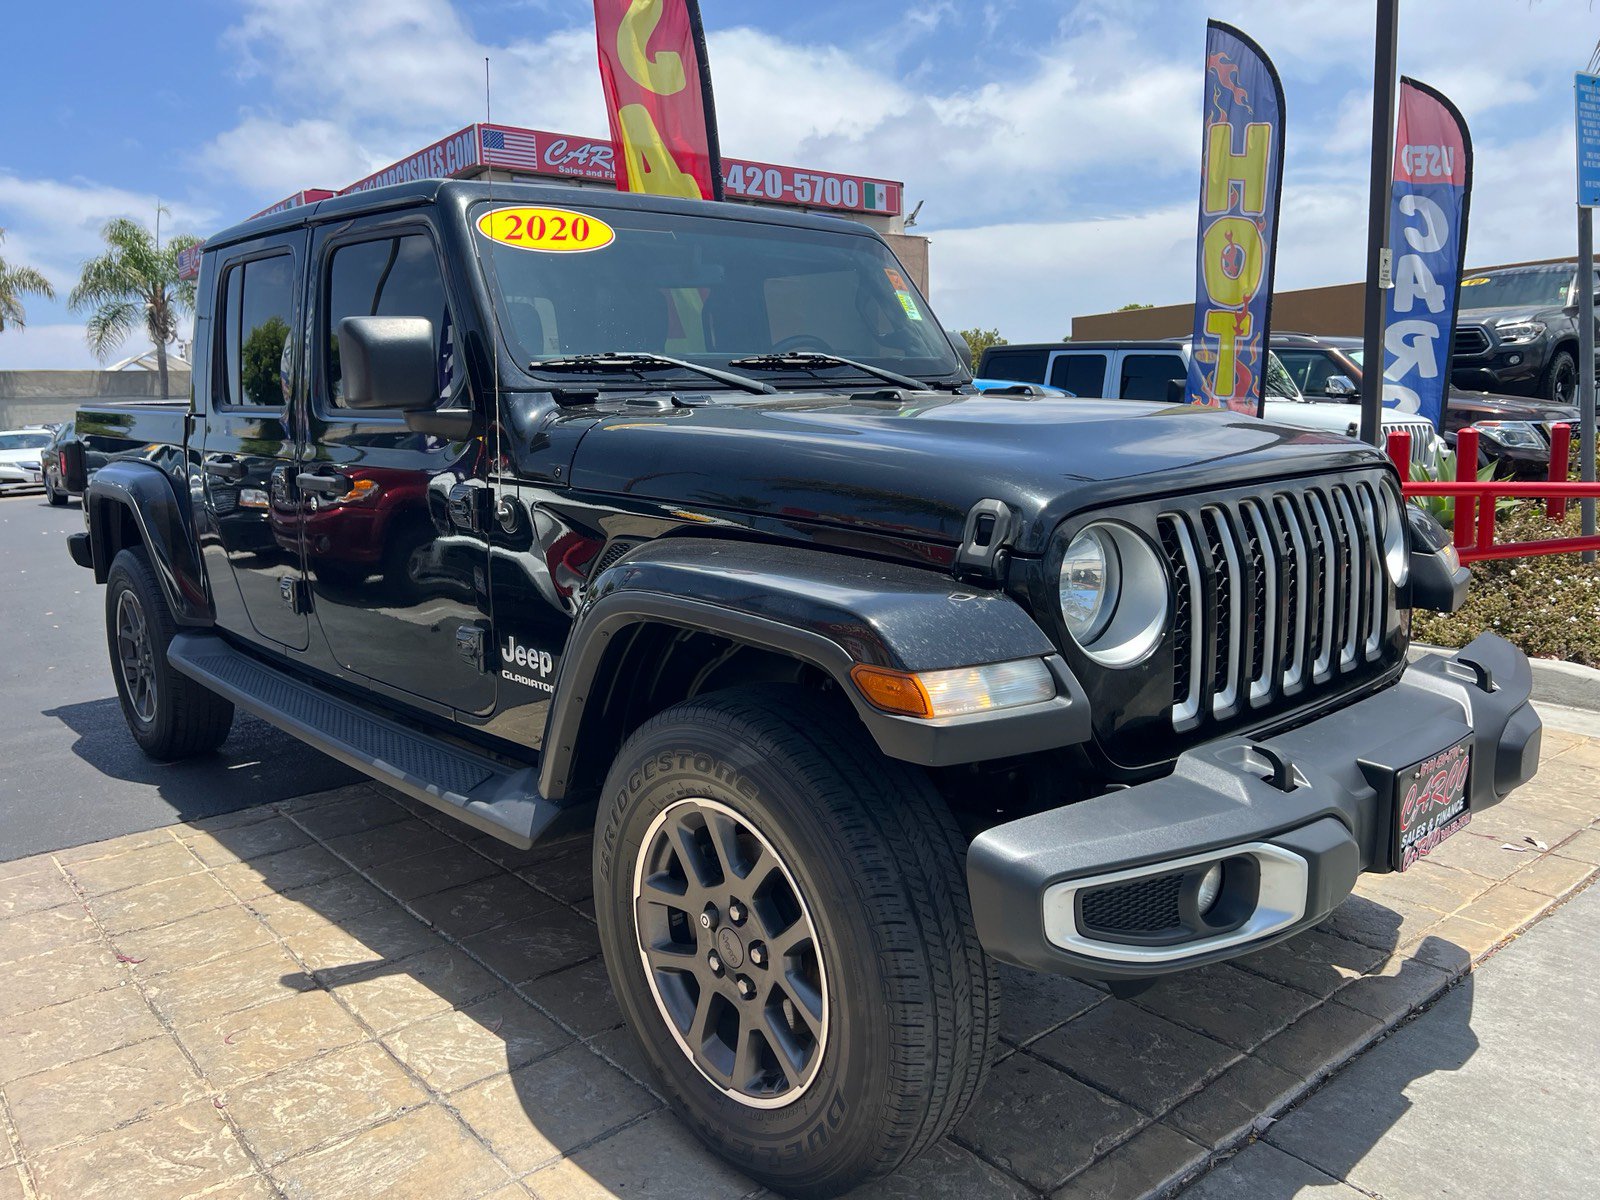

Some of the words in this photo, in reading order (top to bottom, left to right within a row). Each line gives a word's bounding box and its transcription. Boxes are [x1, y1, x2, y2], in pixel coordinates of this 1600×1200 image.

[544, 139, 615, 172] CAR
[559, 165, 583, 175] Sales
[586, 168, 602, 177] and
[504, 210, 590, 242] 2020
[1203, 122, 1273, 397] HOT
[501, 635, 552, 678] Jeep
[601, 750, 760, 883] BRIDGESTONE
[1401, 755, 1469, 832] CARCO
[1401, 822, 1427, 848] SALES
[1427, 817, 1435, 833] &
[1435, 797, 1465, 827] FINANCE
